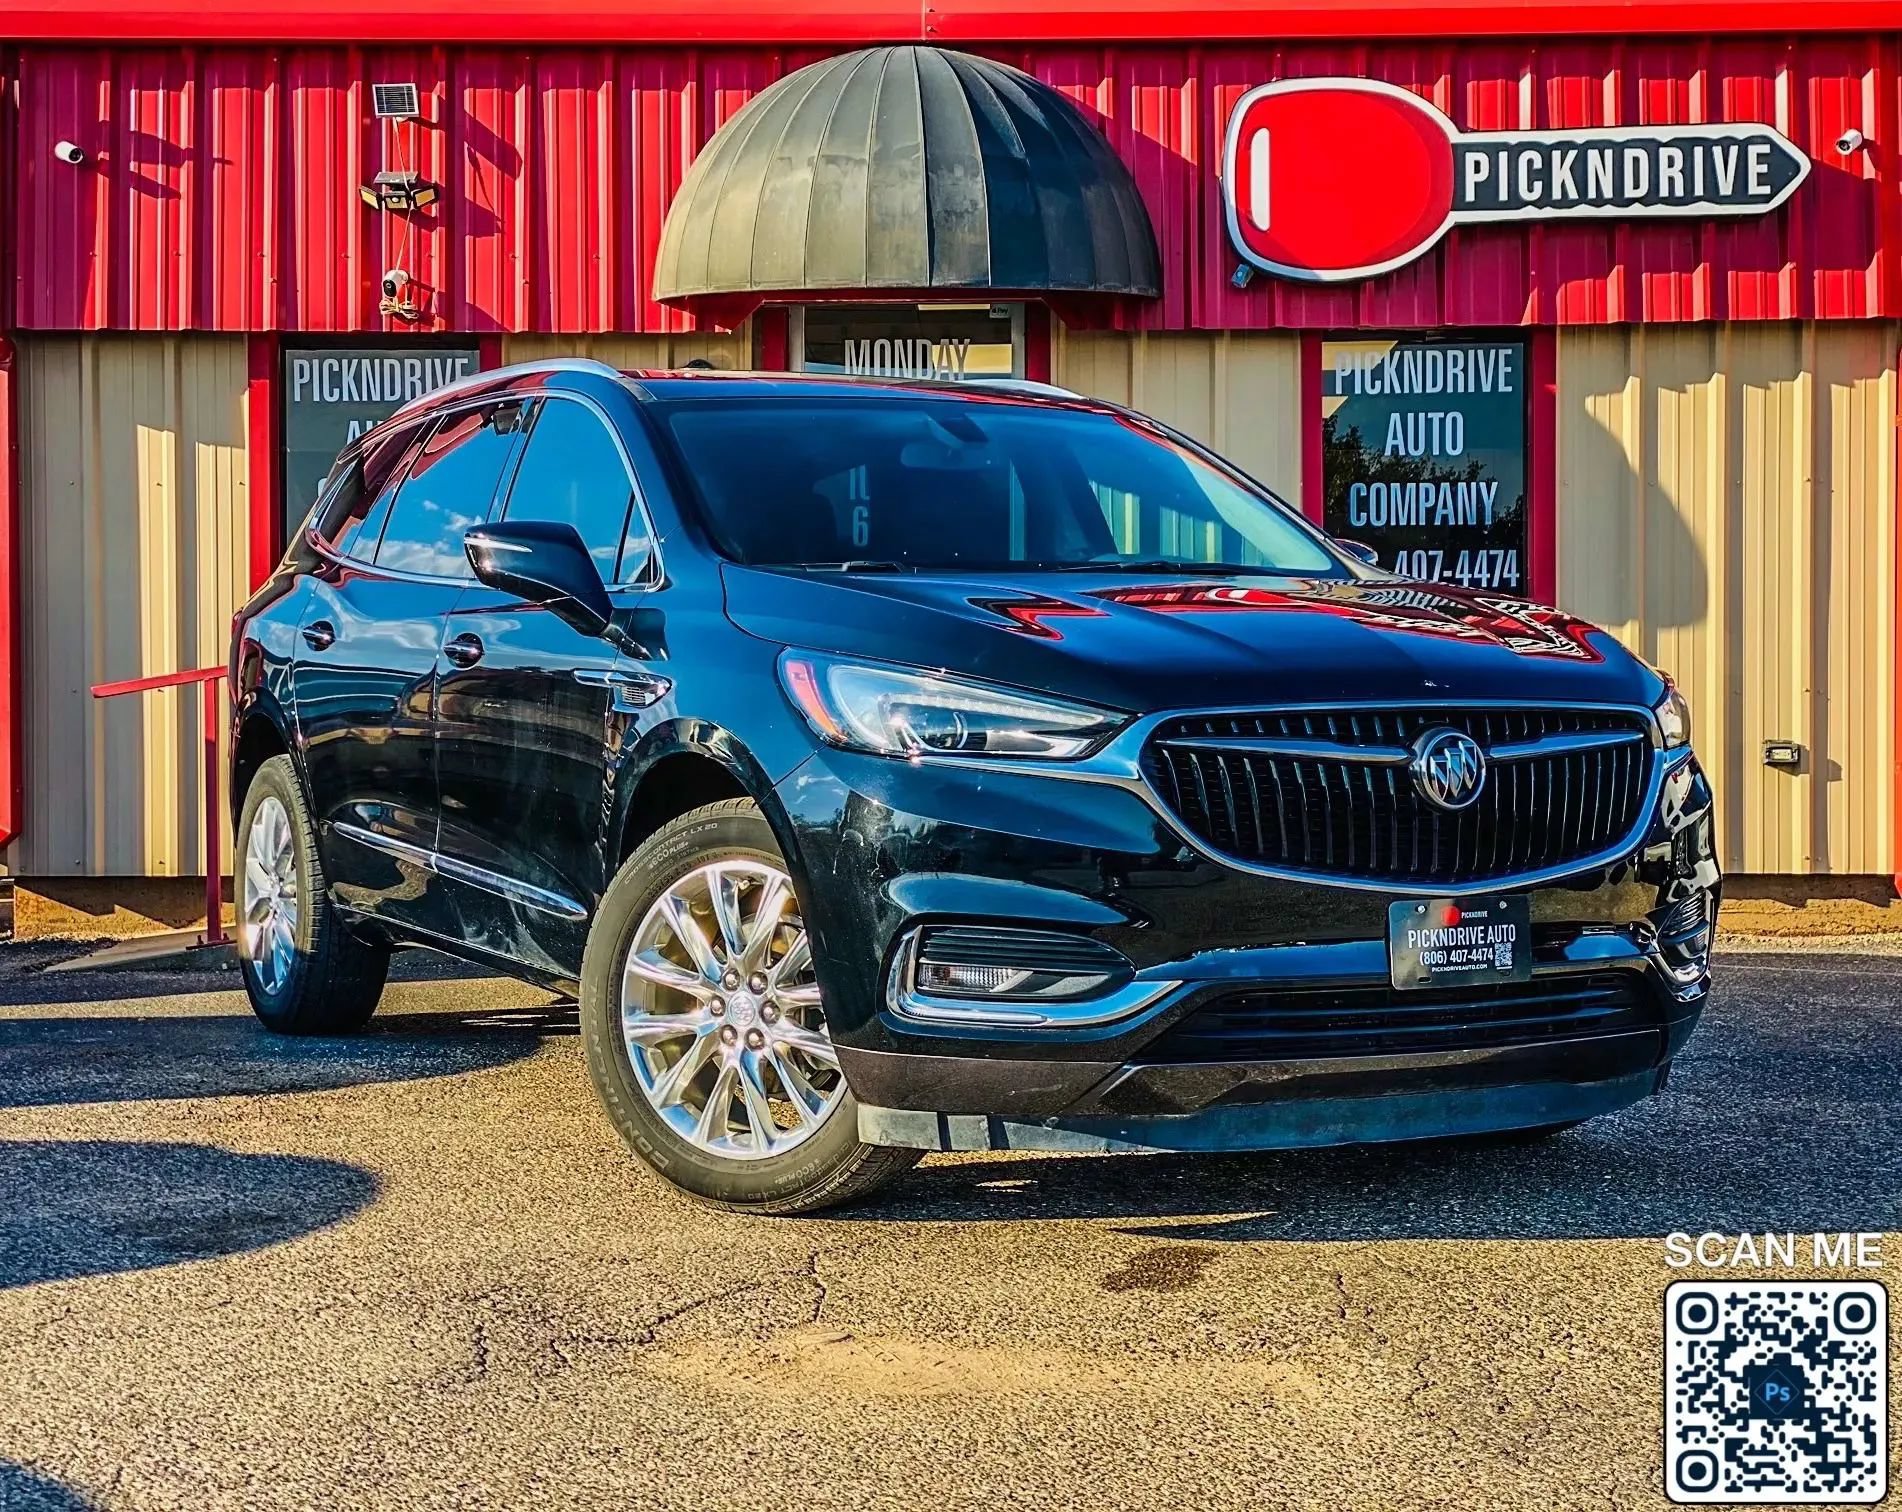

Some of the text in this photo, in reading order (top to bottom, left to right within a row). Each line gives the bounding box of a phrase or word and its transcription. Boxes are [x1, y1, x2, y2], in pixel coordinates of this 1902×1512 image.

[1465, 144, 1771, 202] PICKNDRIVE
[844, 338, 971, 381] MONDAY
[1335, 348, 1513, 395] PICKNDRIVE
[1384, 411, 1464, 457] AUTO
[1350, 481, 1499, 527] COMPANY
[1407, 924, 1516, 949] PICKNDRIVE AUTO
[1420, 947, 1494, 966] (806) 407-4474
[1431, 963, 1488, 973] PICKNDRIVEAUTO.COM
